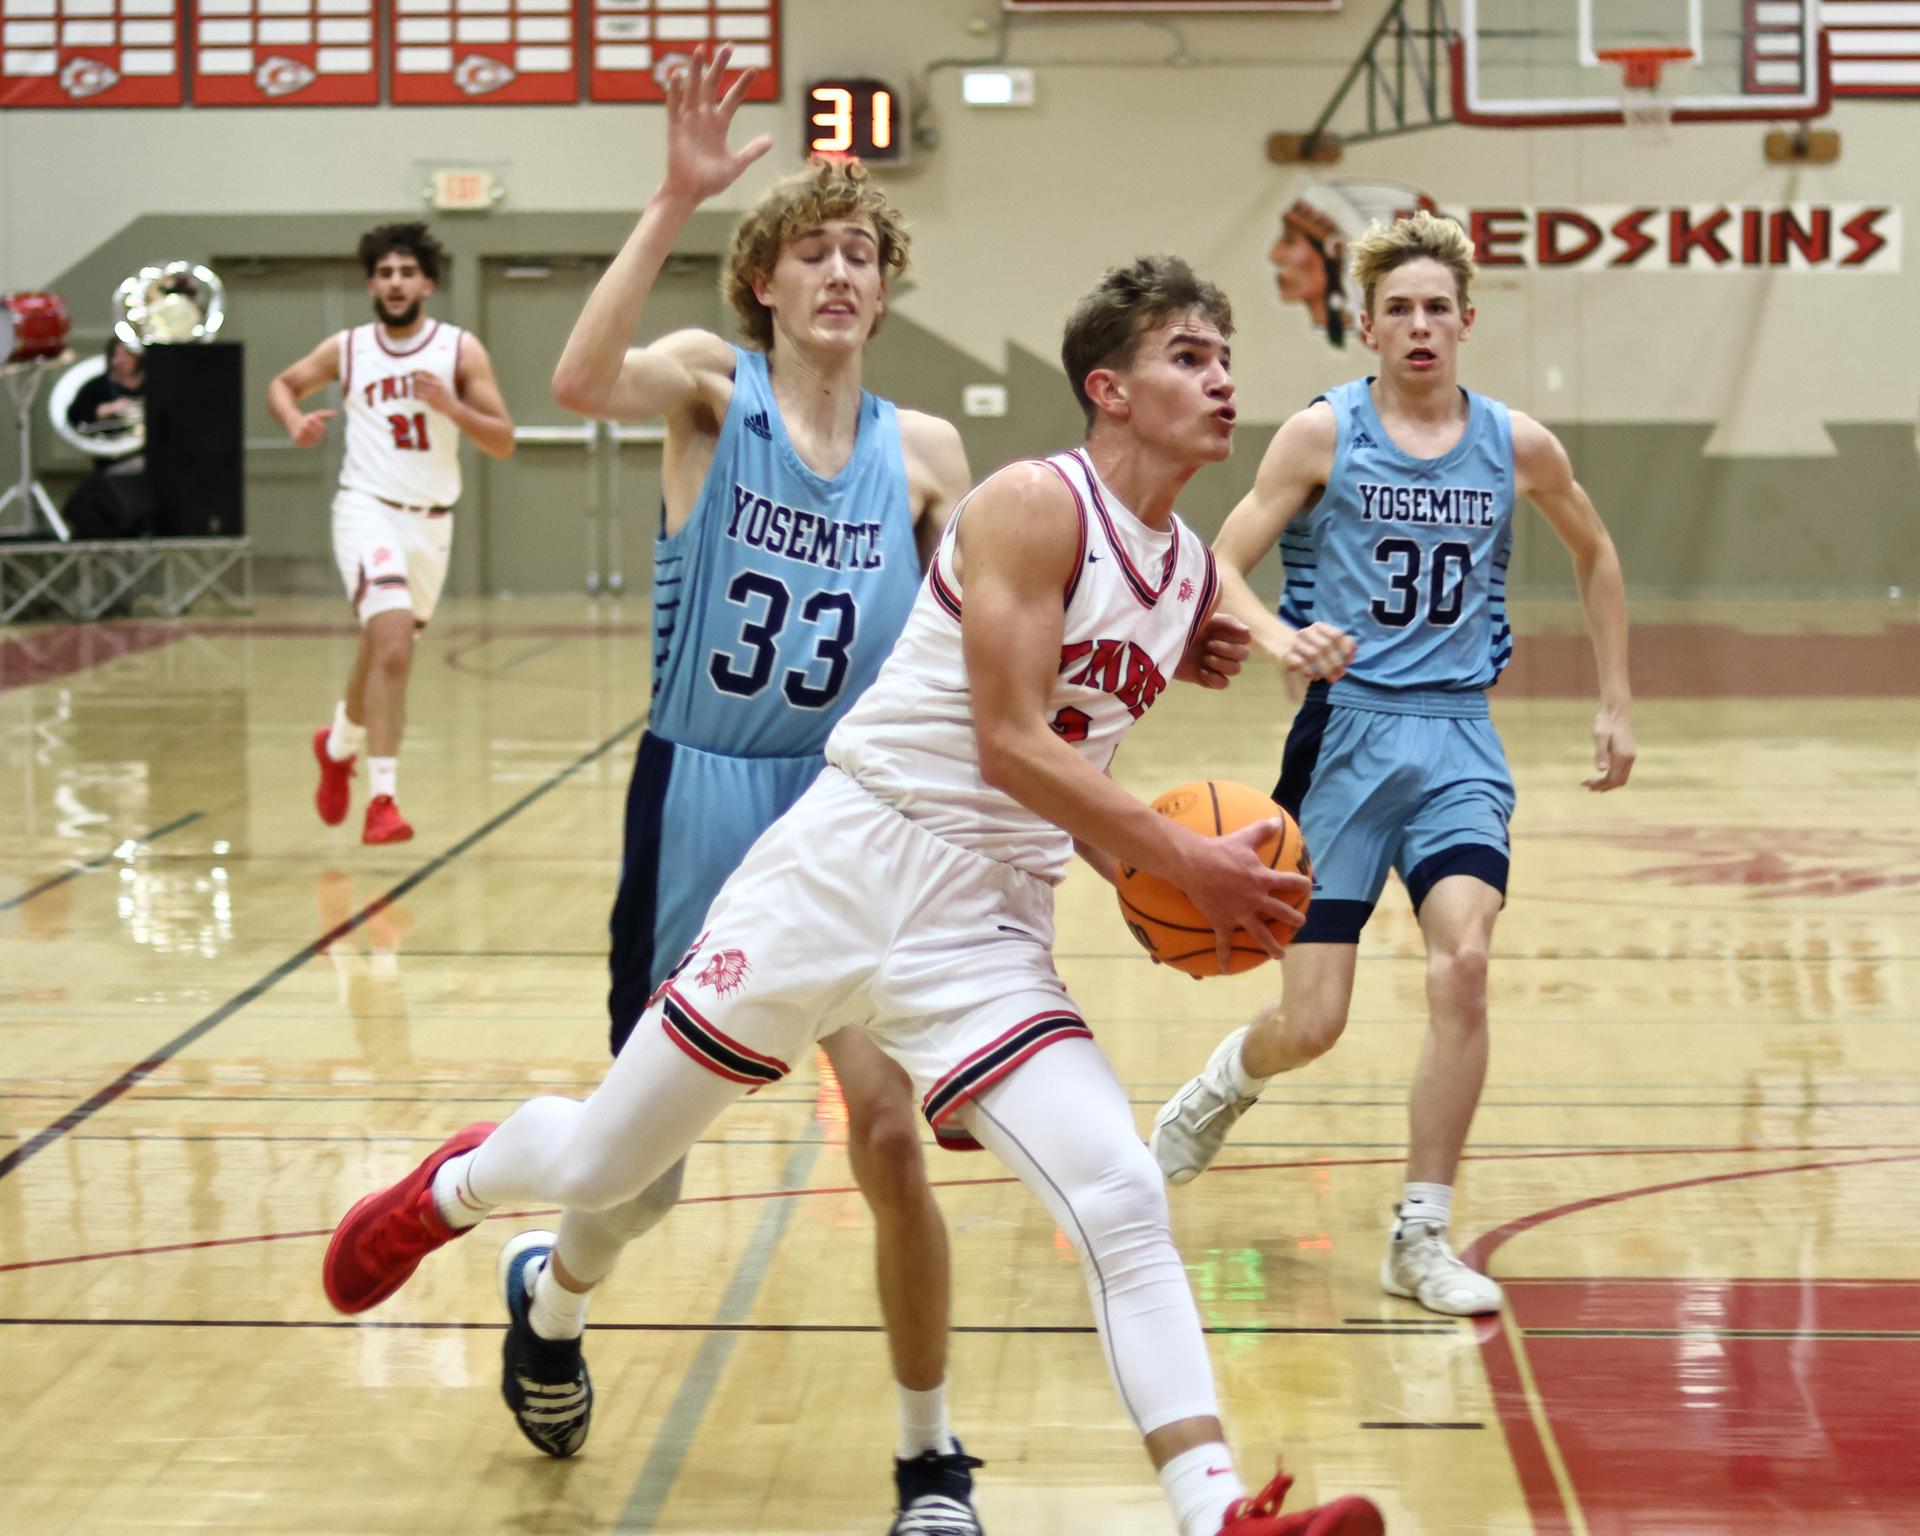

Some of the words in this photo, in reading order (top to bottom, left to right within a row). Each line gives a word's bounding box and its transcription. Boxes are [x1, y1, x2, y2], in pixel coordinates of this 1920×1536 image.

[811, 88, 891, 151] 31
[1469, 207, 1893, 267] EDSKINS
[387, 413, 431, 451] 21
[726, 483, 884, 572] YOSEMTE
[1357, 483, 1494, 527] YOSEMITE
[1369, 536, 1474, 629] 30
[707, 567, 858, 711] 33
